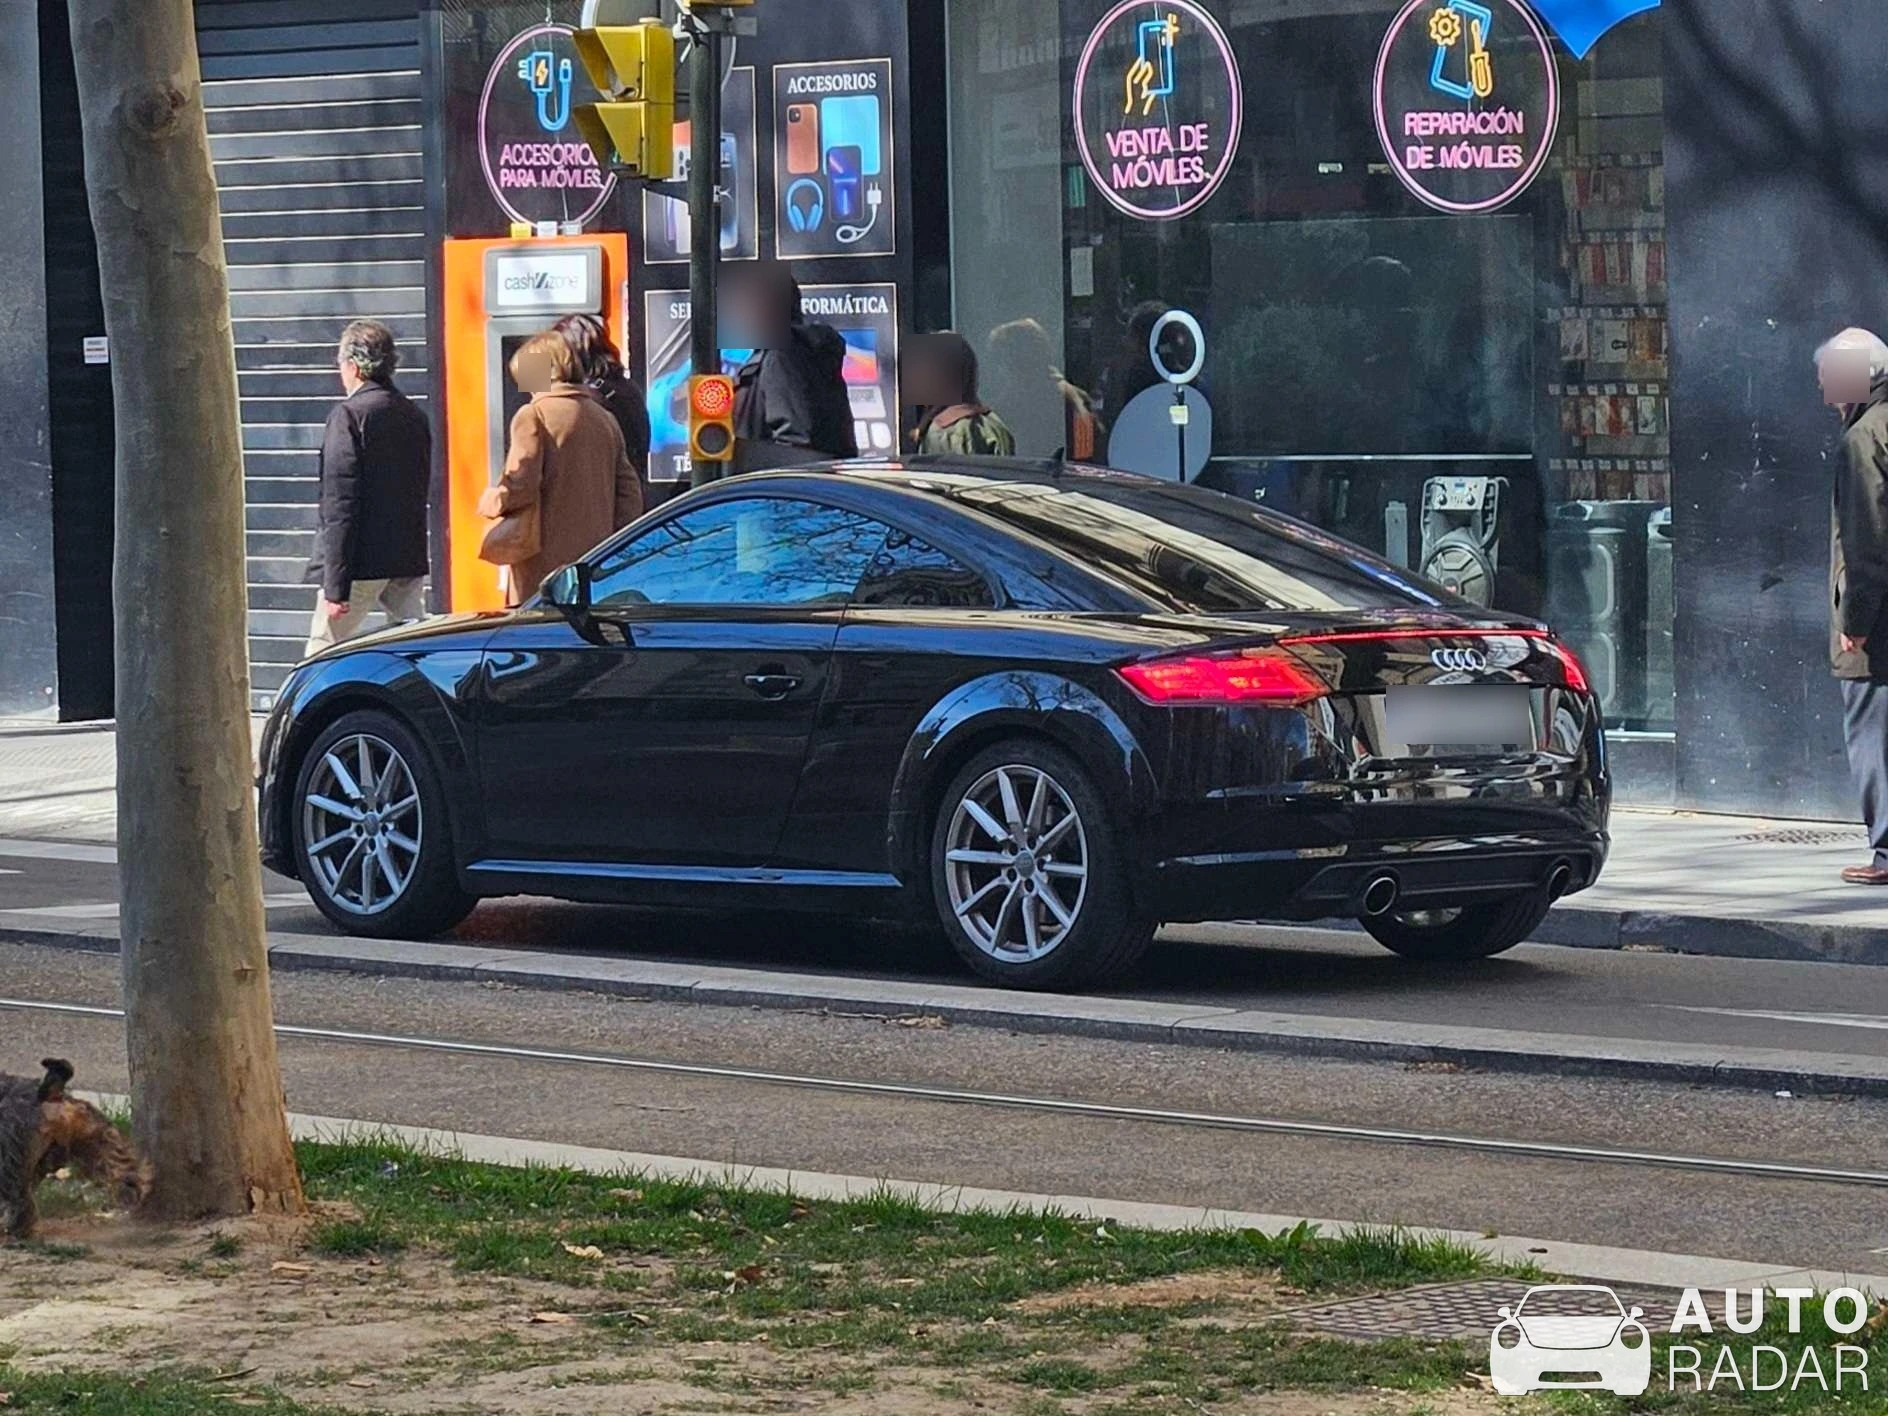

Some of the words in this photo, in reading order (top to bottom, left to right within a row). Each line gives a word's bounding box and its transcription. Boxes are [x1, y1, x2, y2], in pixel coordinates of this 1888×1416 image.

[787, 73, 877, 94] ACCESORIOS
[1404, 106, 1524, 136] REPARACIÓN
[1105, 127, 1174, 157] VENTA
[1179, 123, 1209, 152] DE
[500, 143, 599, 166] ACCESORIO
[1406, 146, 1434, 169] DE
[1439, 141, 1524, 168] MÓVILES
[500, 169, 536, 188] PARA
[541, 164, 601, 188] MÓVILES
[1112, 155, 1204, 190] MÓVILES
[800, 294, 888, 315] FORMÁTICA
